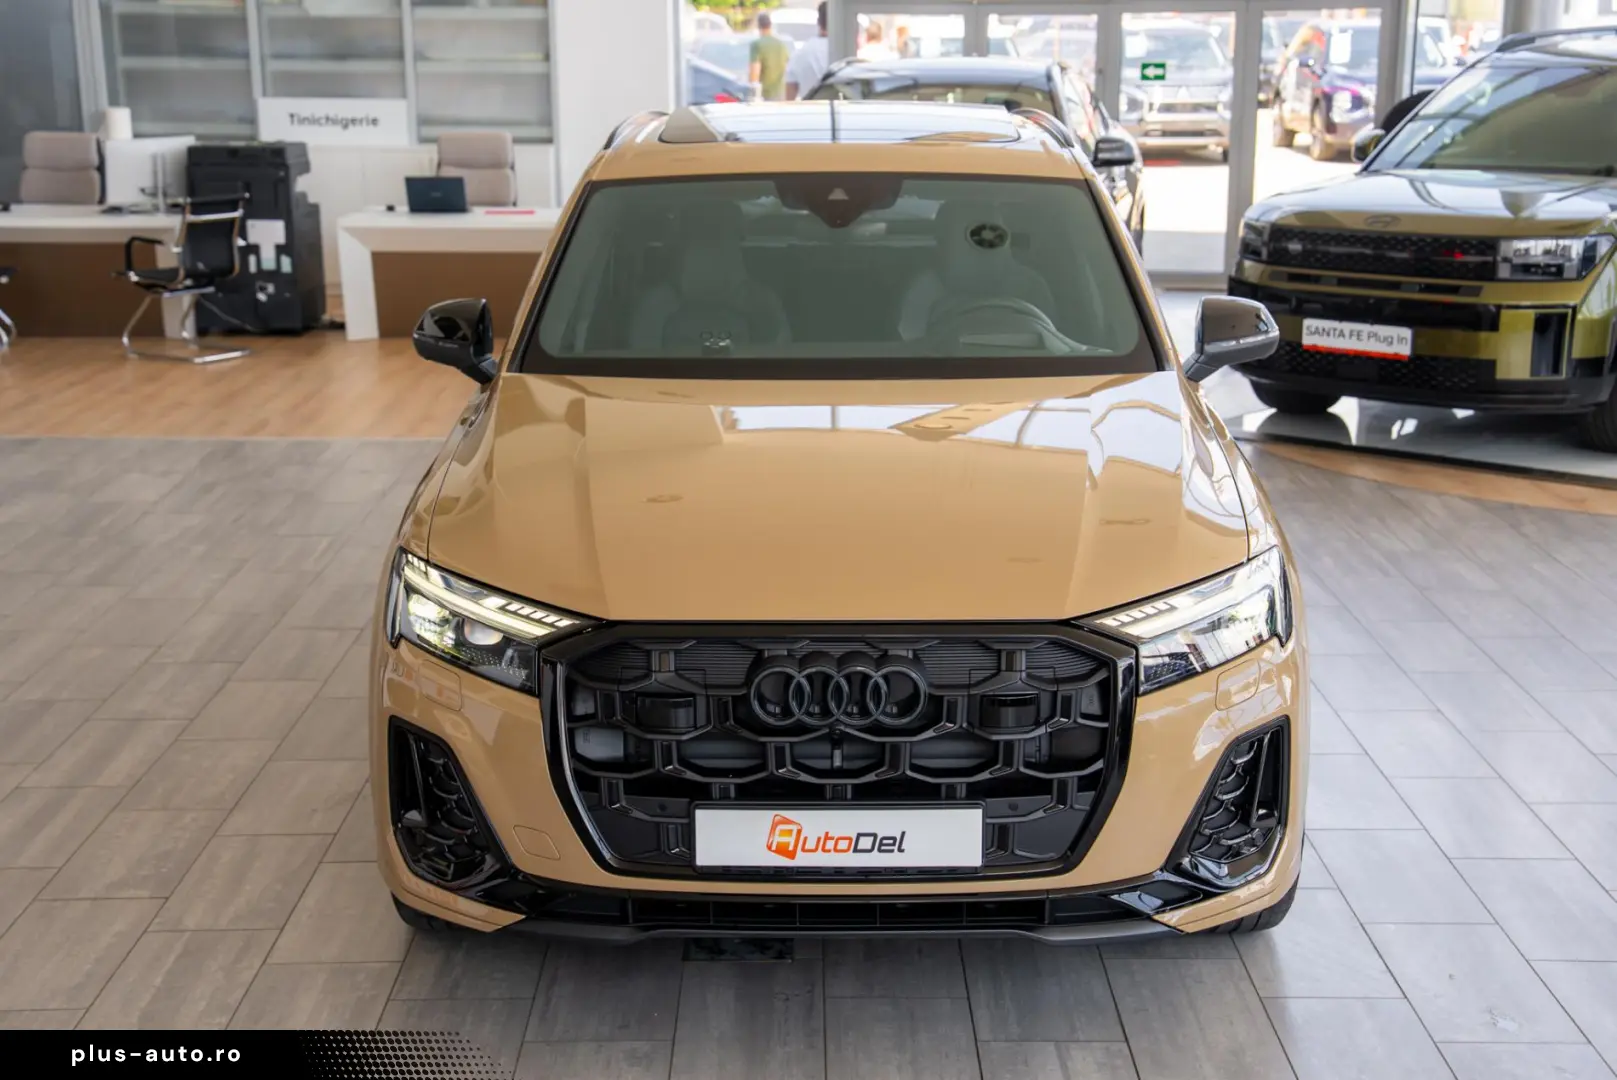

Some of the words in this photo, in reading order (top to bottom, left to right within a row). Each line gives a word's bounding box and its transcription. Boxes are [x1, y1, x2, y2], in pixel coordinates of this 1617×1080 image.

[288, 112, 379, 131] Tinichigerie
[1305, 325, 1345, 340] SANTA
[1349, 329, 1364, 341] FE
[1367, 330, 1394, 347] Plug
[769, 822, 906, 854] AutoDel
